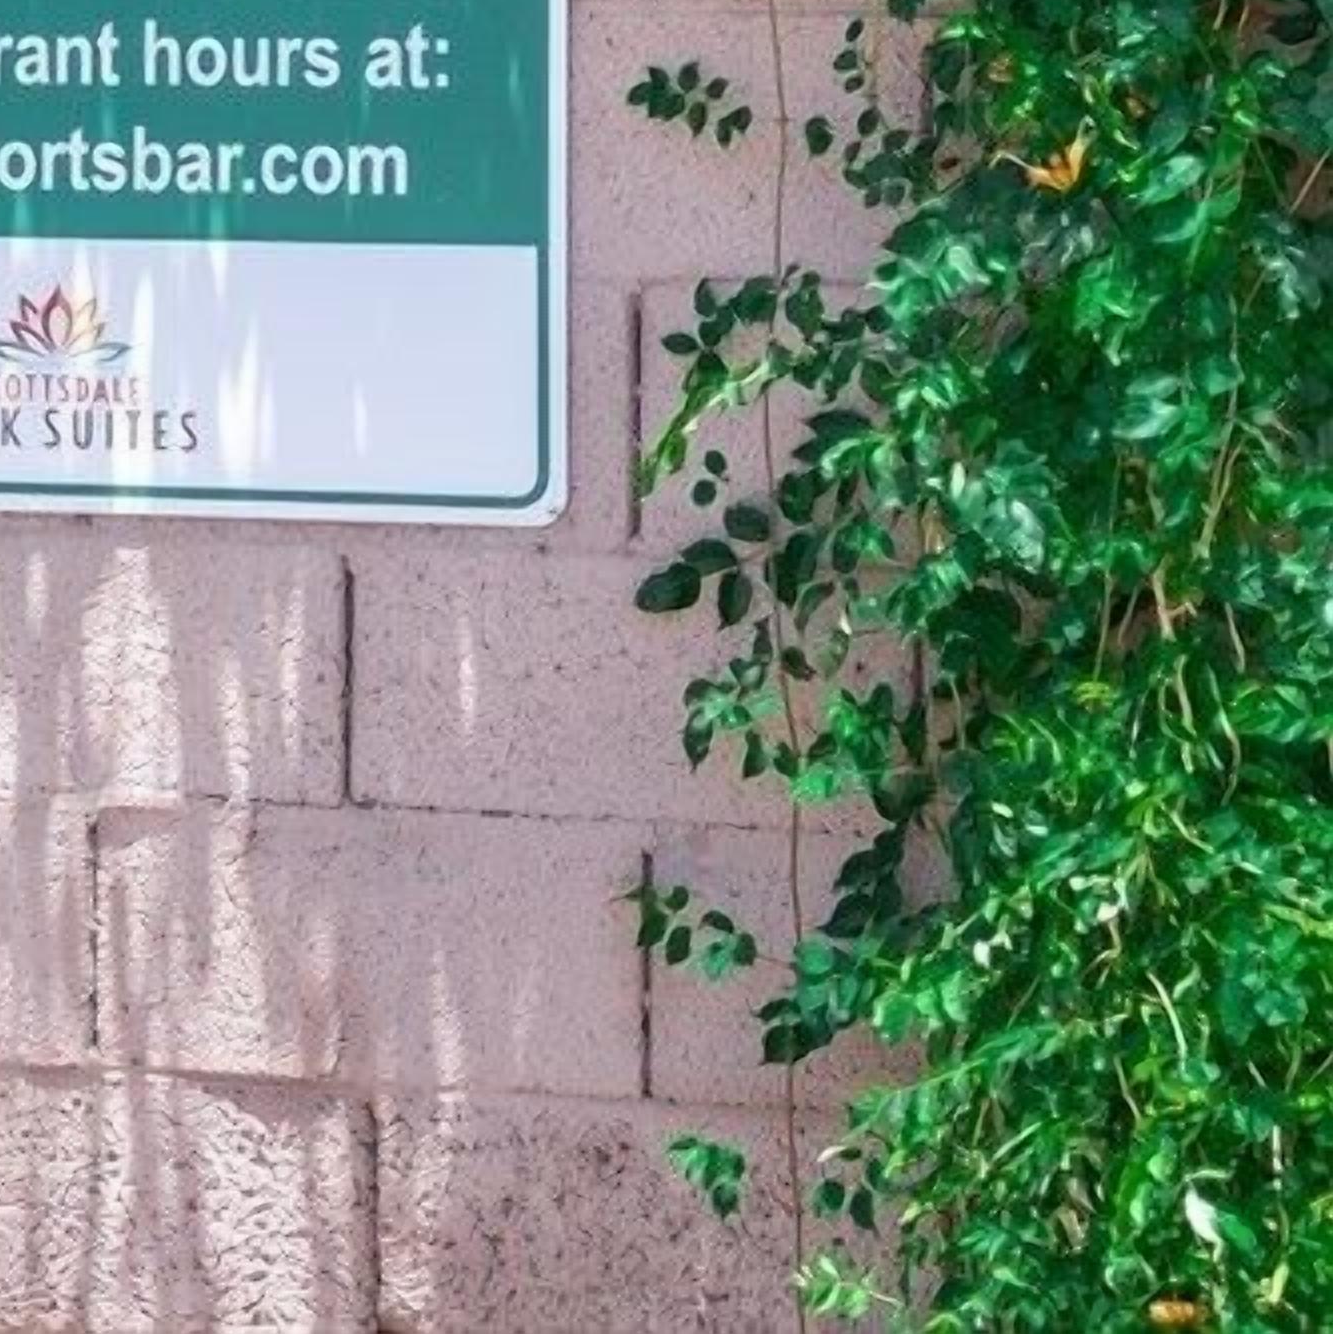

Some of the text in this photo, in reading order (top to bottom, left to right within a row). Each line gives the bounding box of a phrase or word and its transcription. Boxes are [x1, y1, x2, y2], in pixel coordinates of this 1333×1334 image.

[144, 18, 341, 89] hours
[364, 22, 450, 89] at:
[43, 410, 199, 451] SUITES
